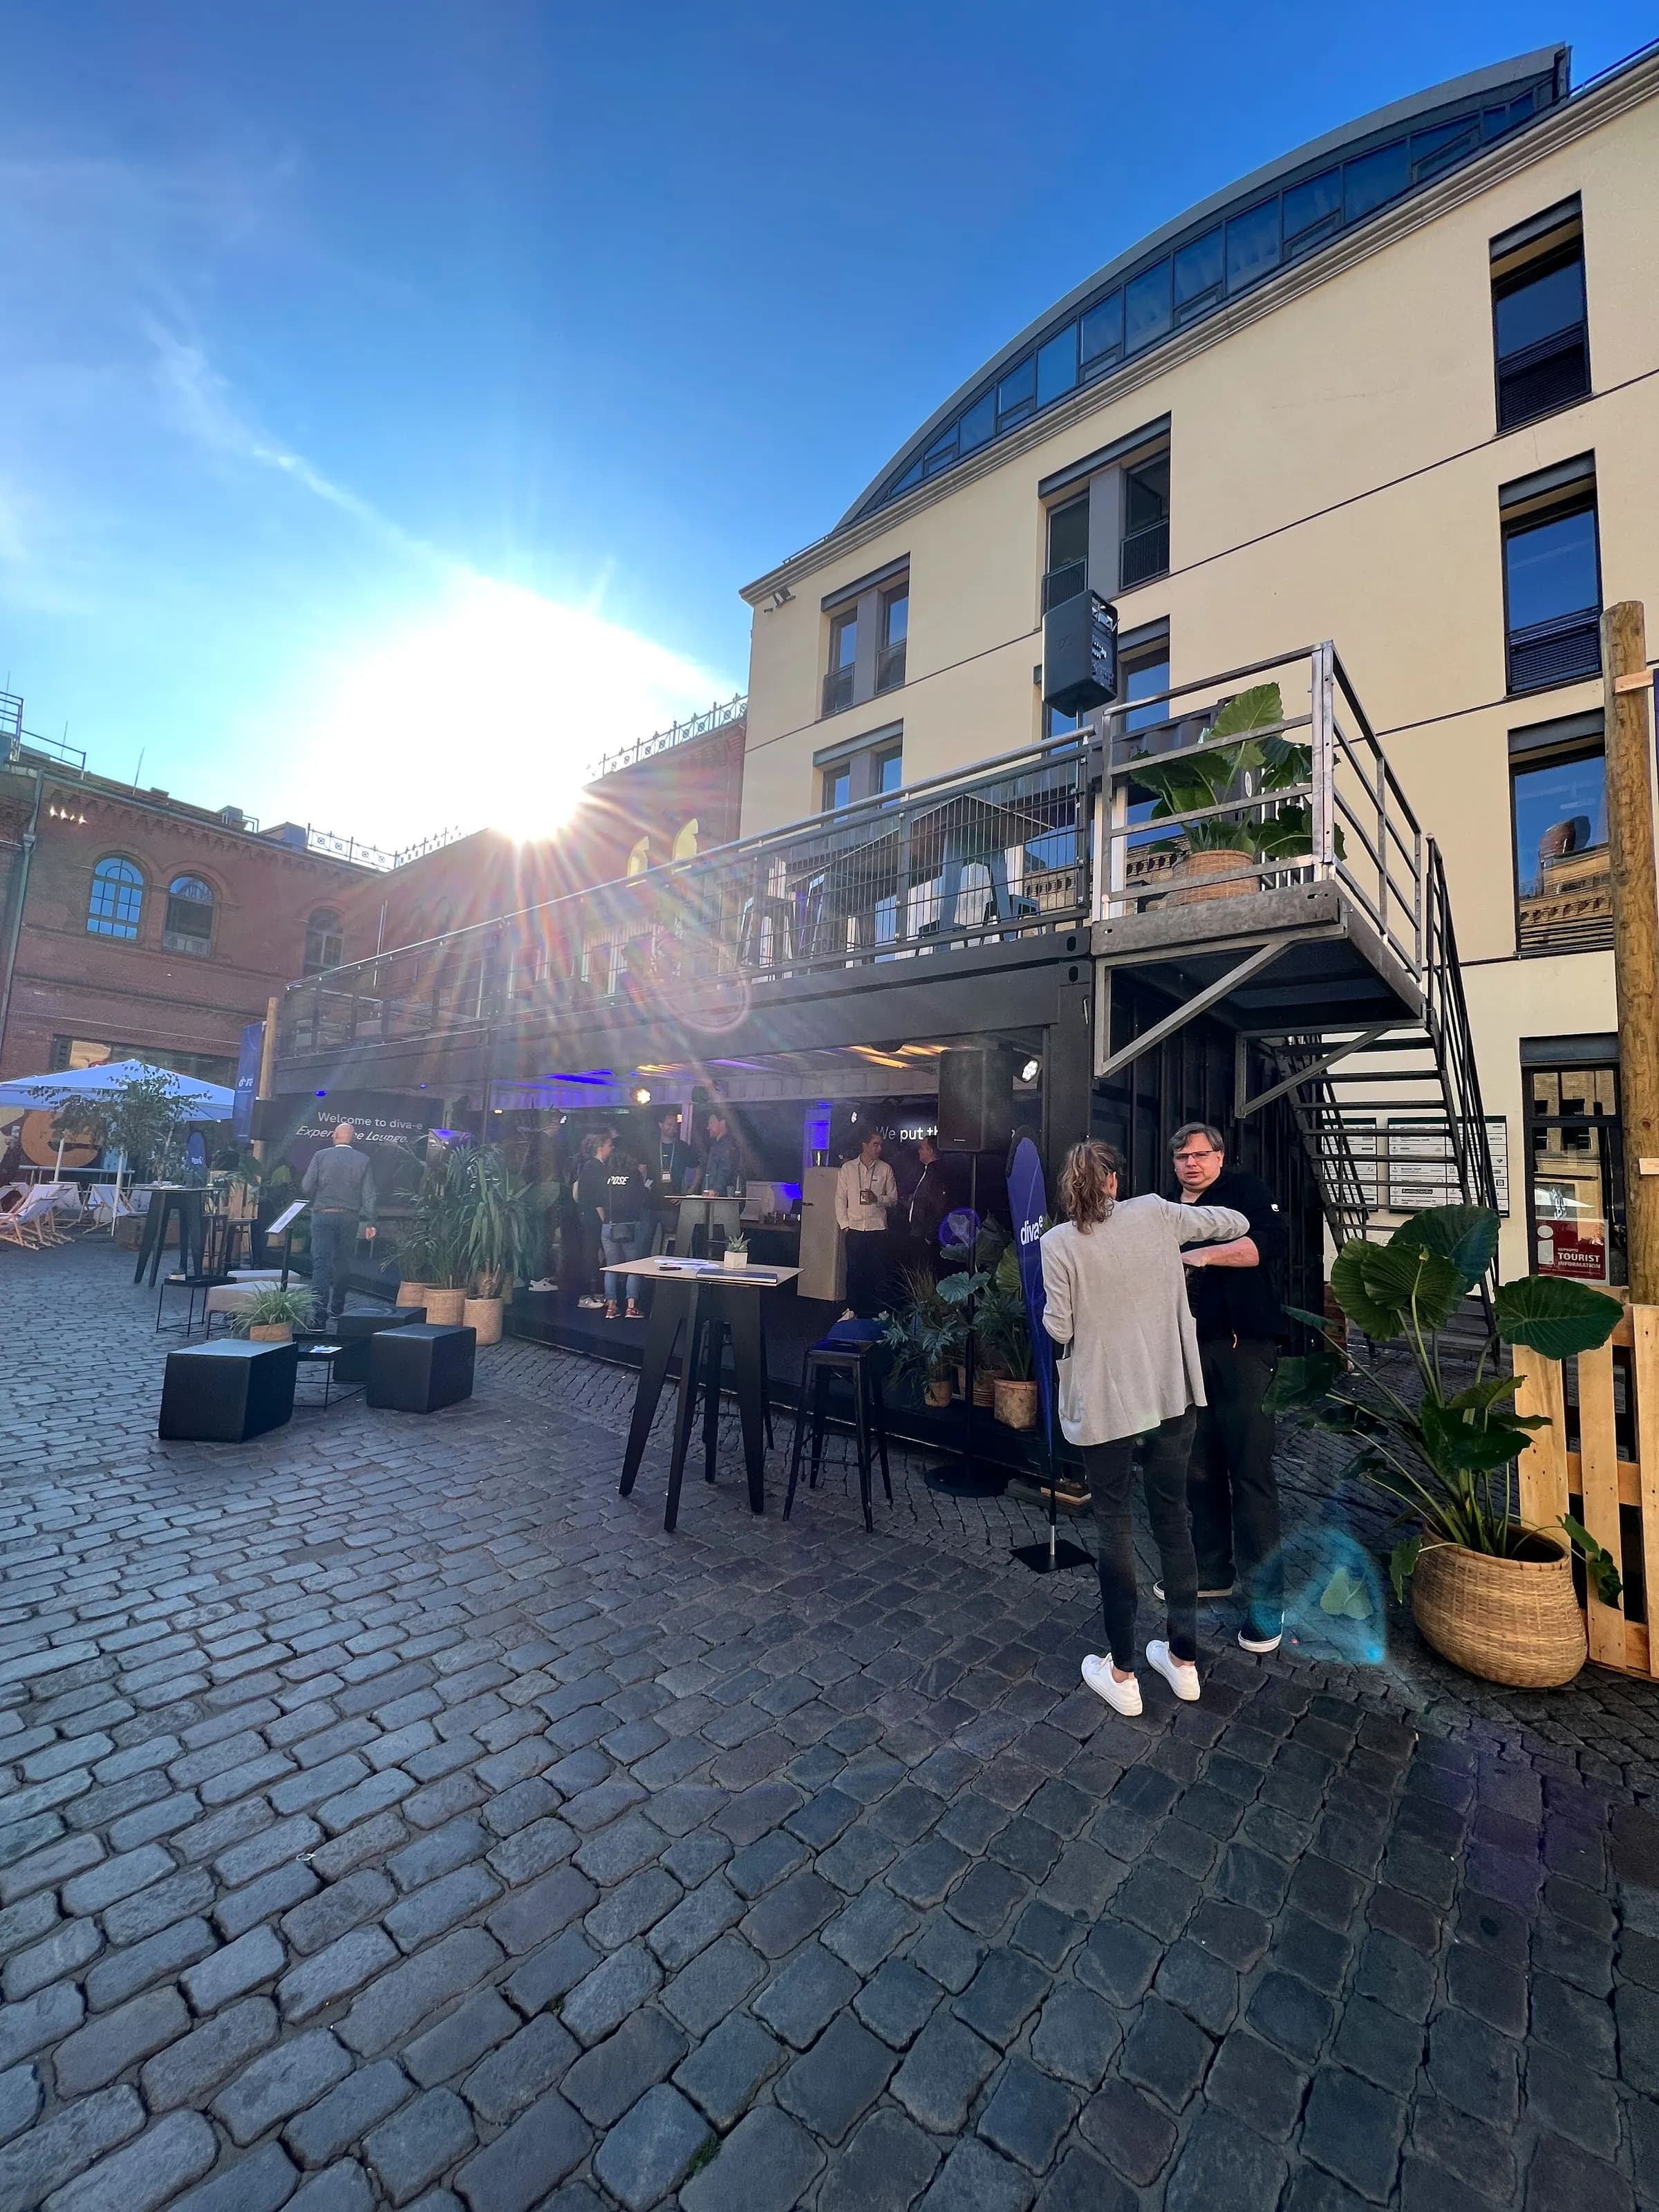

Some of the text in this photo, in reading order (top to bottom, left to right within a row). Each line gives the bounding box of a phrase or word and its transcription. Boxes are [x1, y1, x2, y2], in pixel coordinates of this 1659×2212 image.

[317, 1112, 423, 1130] Welcome to diva-e
[900, 1126, 924, 1143] put
[1557, 1252, 1601, 1262] TOURIST
[1557, 1261, 1601, 1269] INFORMATION
